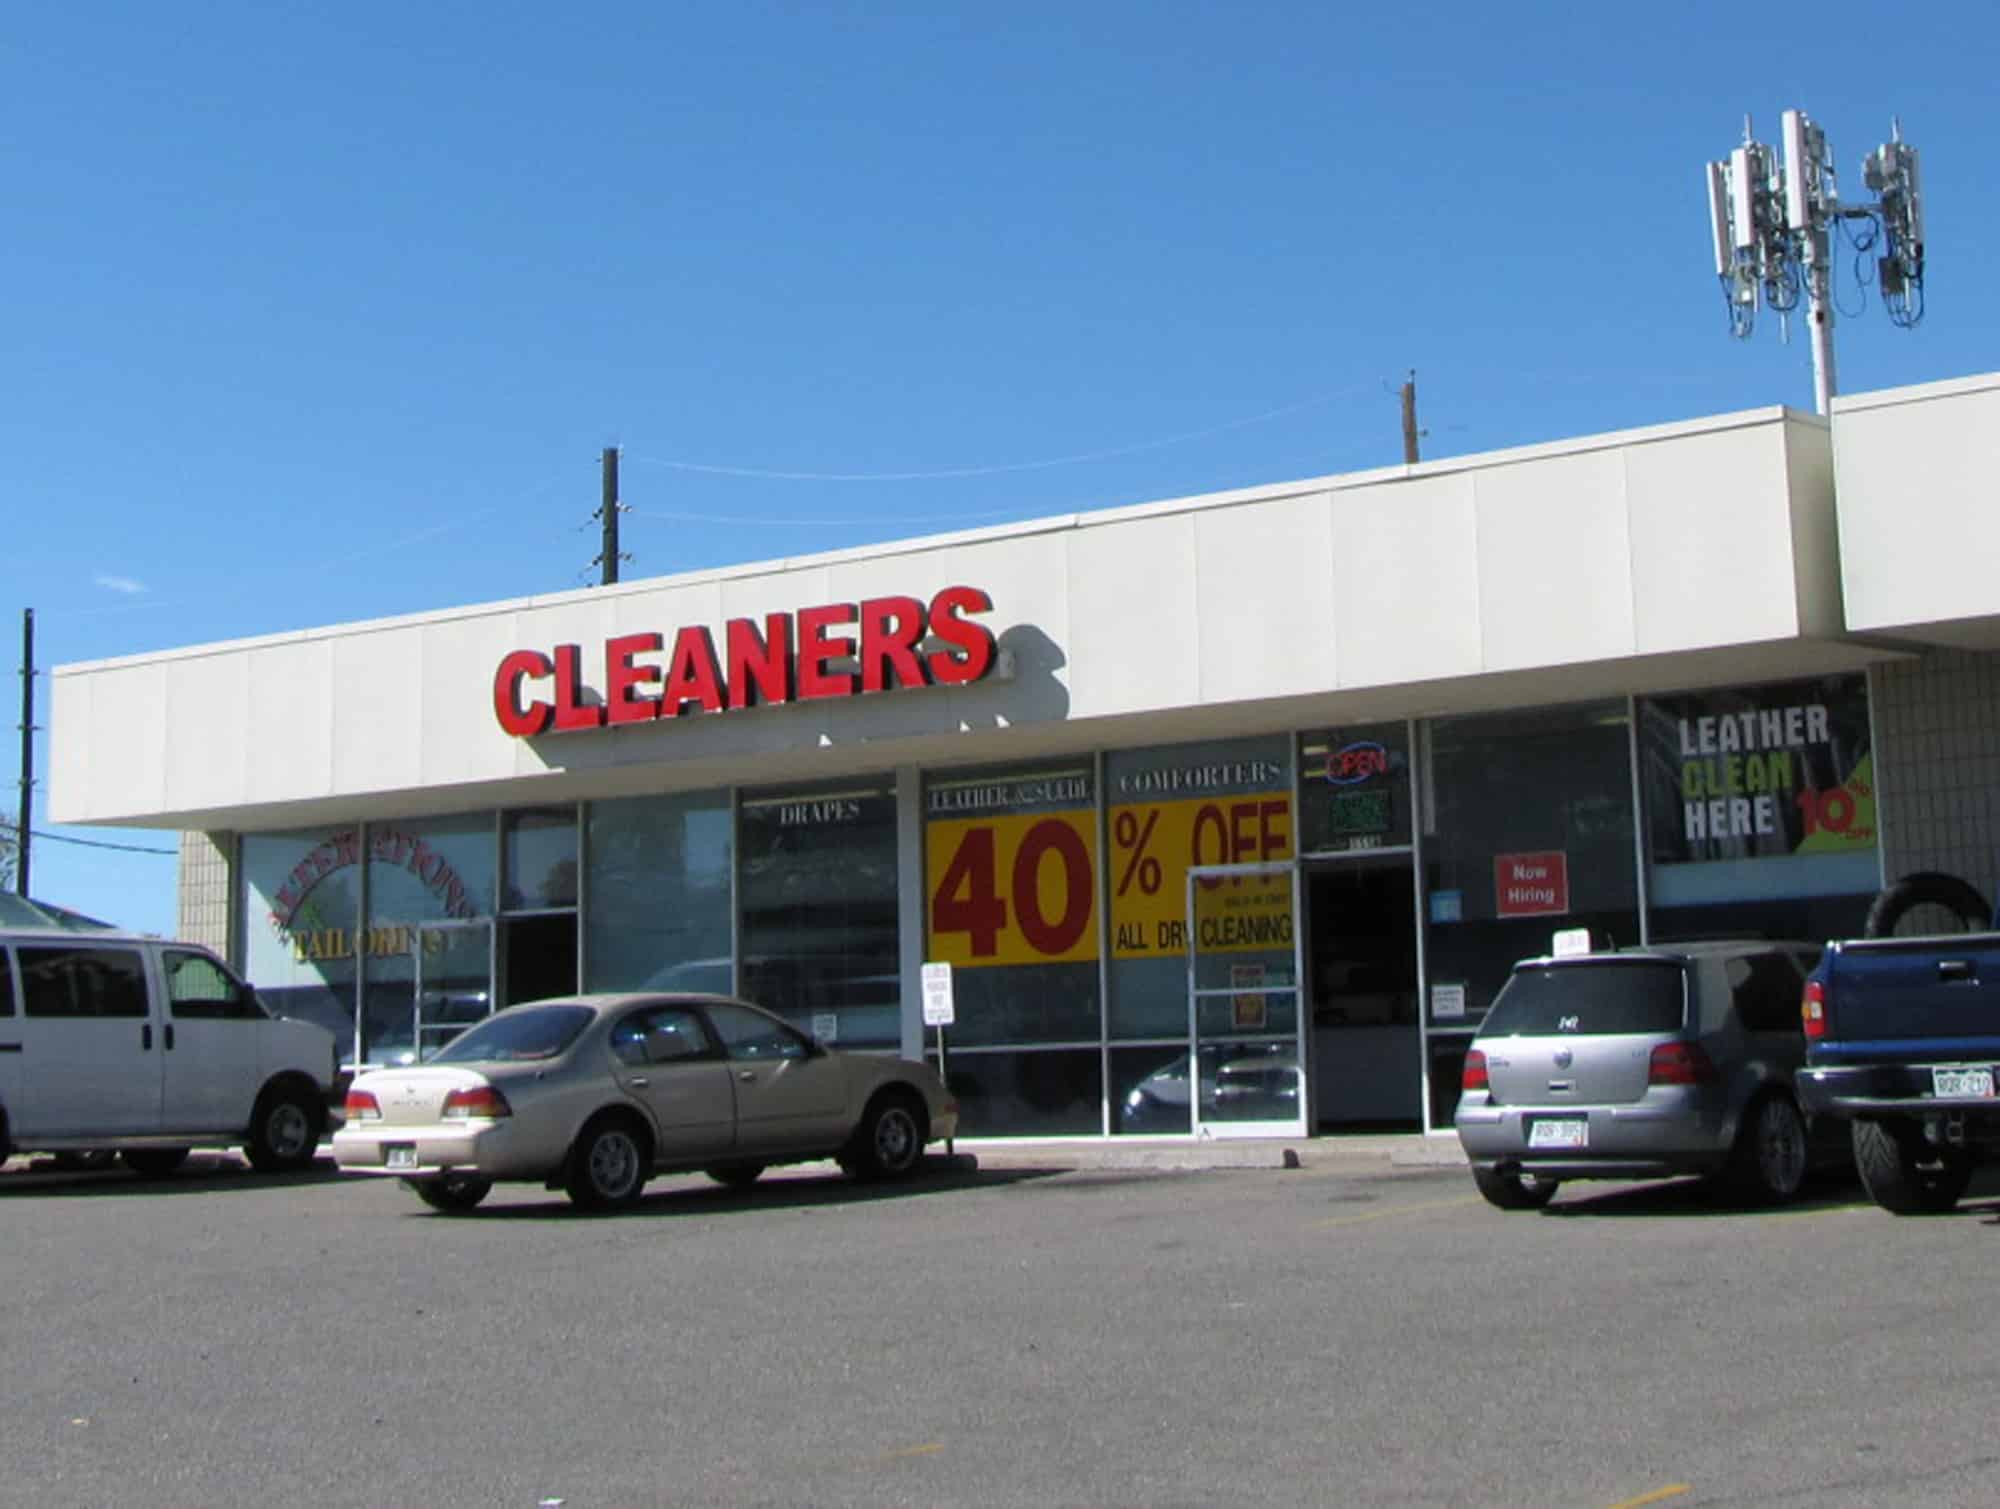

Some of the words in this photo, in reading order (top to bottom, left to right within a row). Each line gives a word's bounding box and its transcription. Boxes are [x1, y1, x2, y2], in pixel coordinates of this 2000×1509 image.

[494, 586, 998, 738] CLEANERS
[1680, 704, 1829, 755] LEATHER
[1120, 761, 1281, 793] COMFORTERS
[1327, 750, 1388, 777] OPEN
[1681, 751, 1793, 796] CLEAN
[780, 801, 860, 825] DRAPES
[1685, 796, 1775, 840] HERE
[1798, 785, 1857, 834] 10
[932, 818, 1092, 957] 40
[1192, 800, 1288, 889] OFF
[1513, 864, 1547, 880] Now
[1507, 886, 1555, 904] Hiring
[1116, 923, 1149, 950] ALL
[1200, 914, 1294, 947] CLEANING
